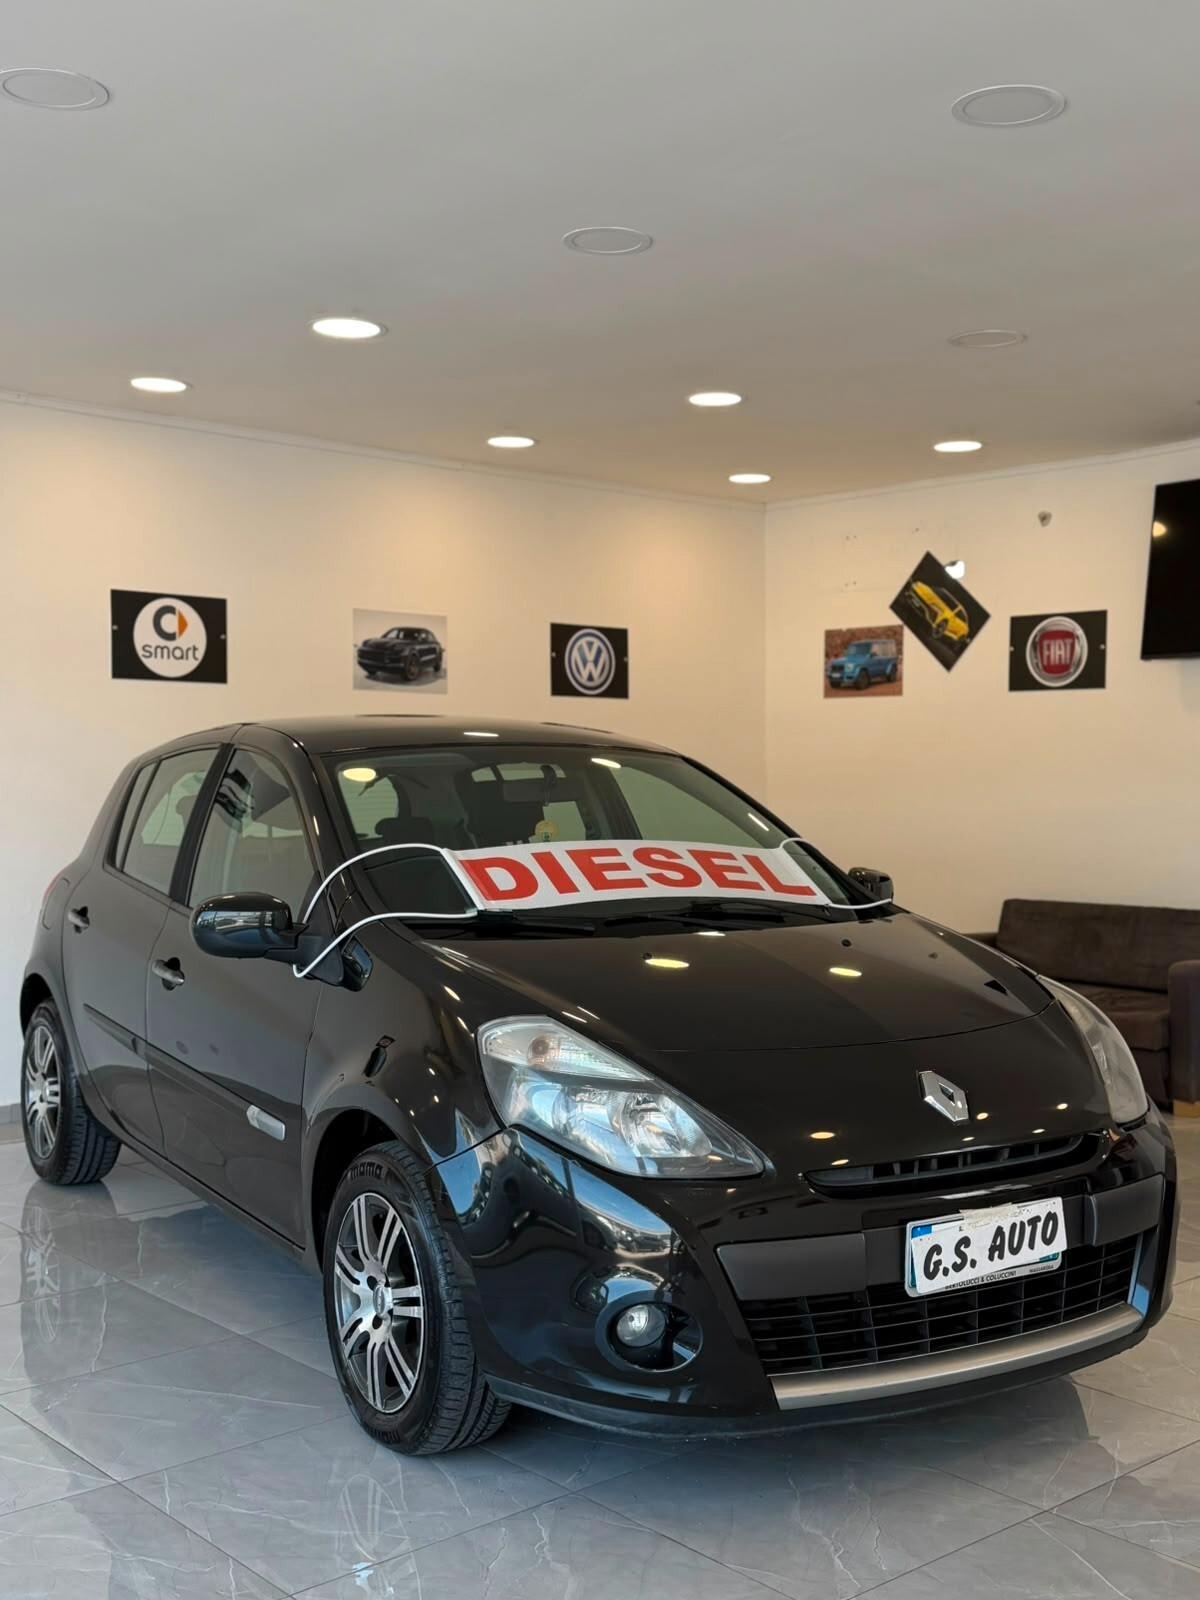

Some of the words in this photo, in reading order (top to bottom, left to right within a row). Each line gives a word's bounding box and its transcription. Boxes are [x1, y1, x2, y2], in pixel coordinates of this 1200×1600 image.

[141, 643, 200, 661] smart
[1043, 638, 1073, 666] FIAT
[460, 846, 818, 902] DIESEL
[923, 1235, 977, 1281] G.S.
[988, 1210, 1059, 1262] AUTO
